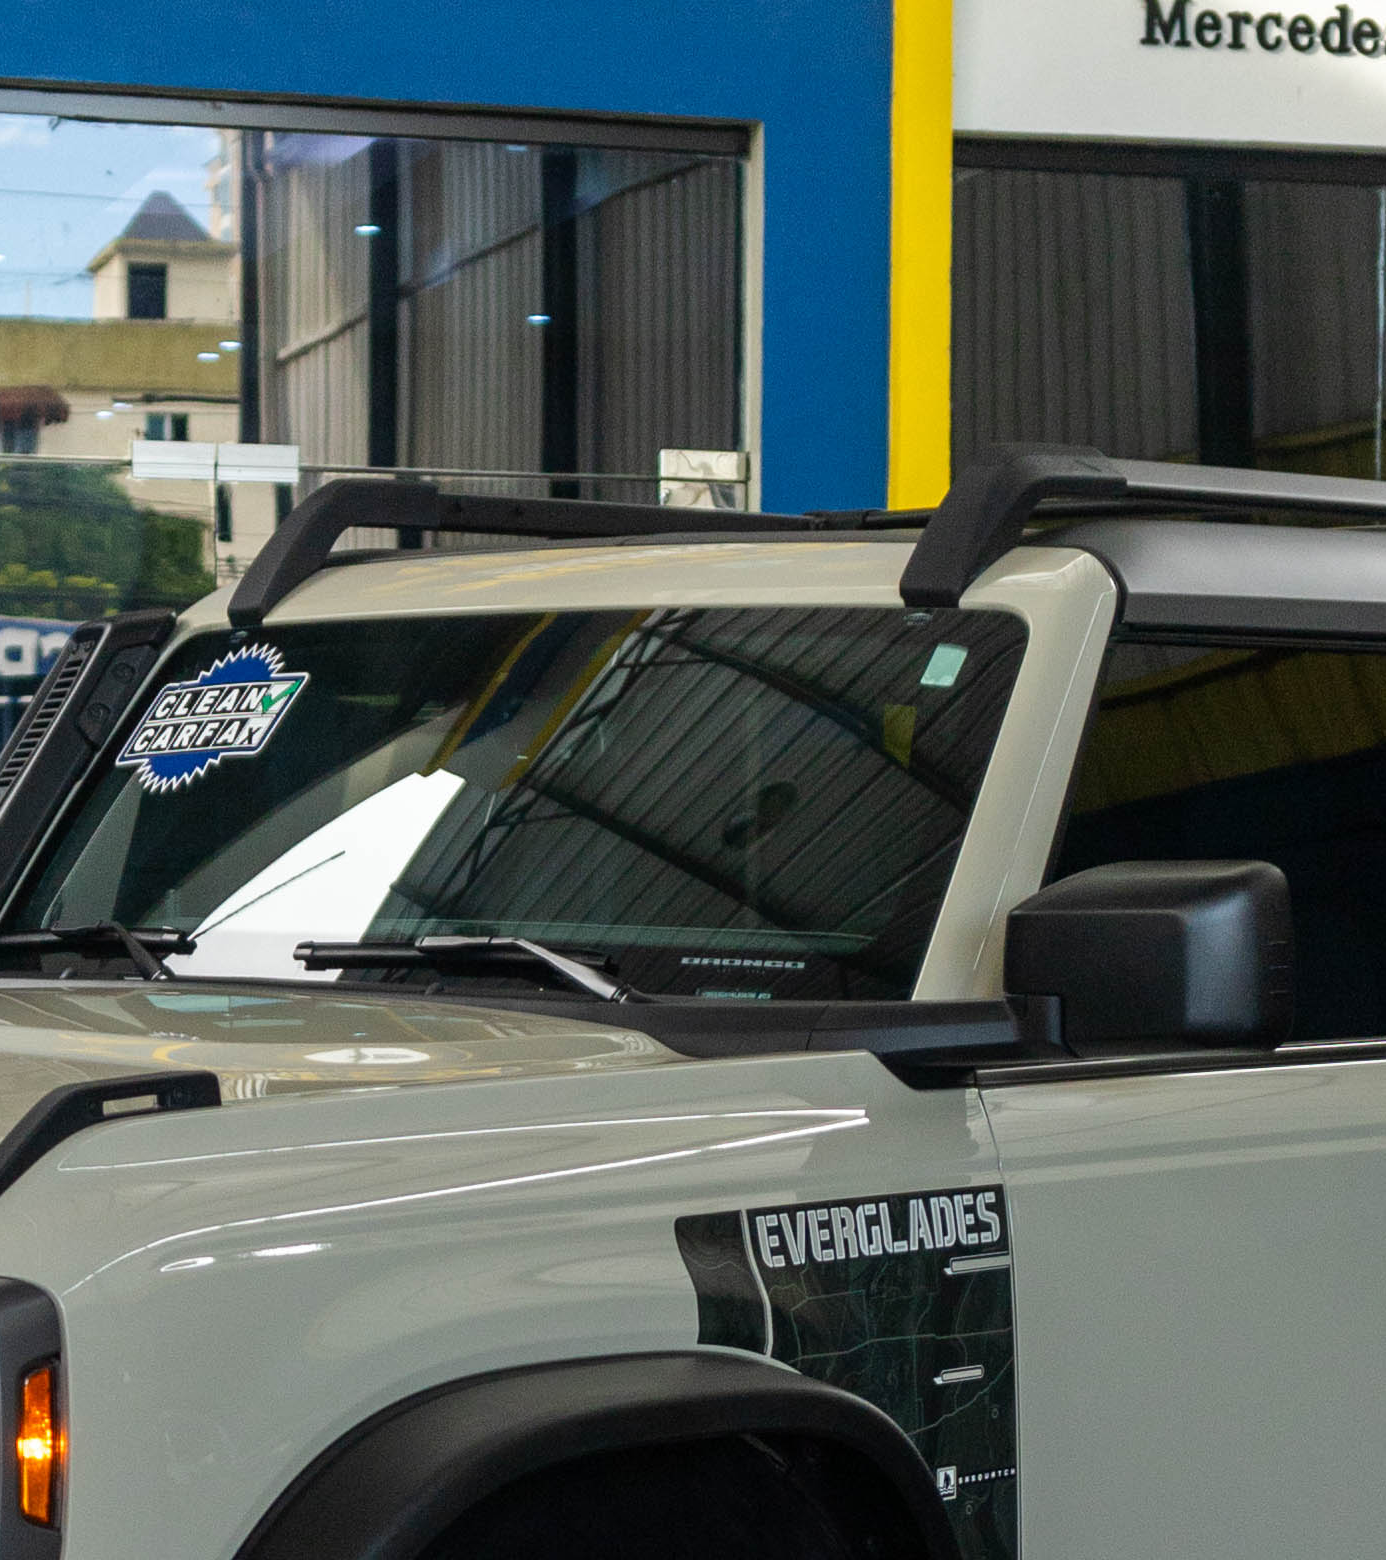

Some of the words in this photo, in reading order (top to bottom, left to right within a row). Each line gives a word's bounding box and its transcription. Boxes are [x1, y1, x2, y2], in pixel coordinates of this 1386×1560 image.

[153, 683, 269, 720] CLEAN
[132, 719, 263, 752] CARFAX
[755, 1191, 1002, 1268] EVERGLADES
